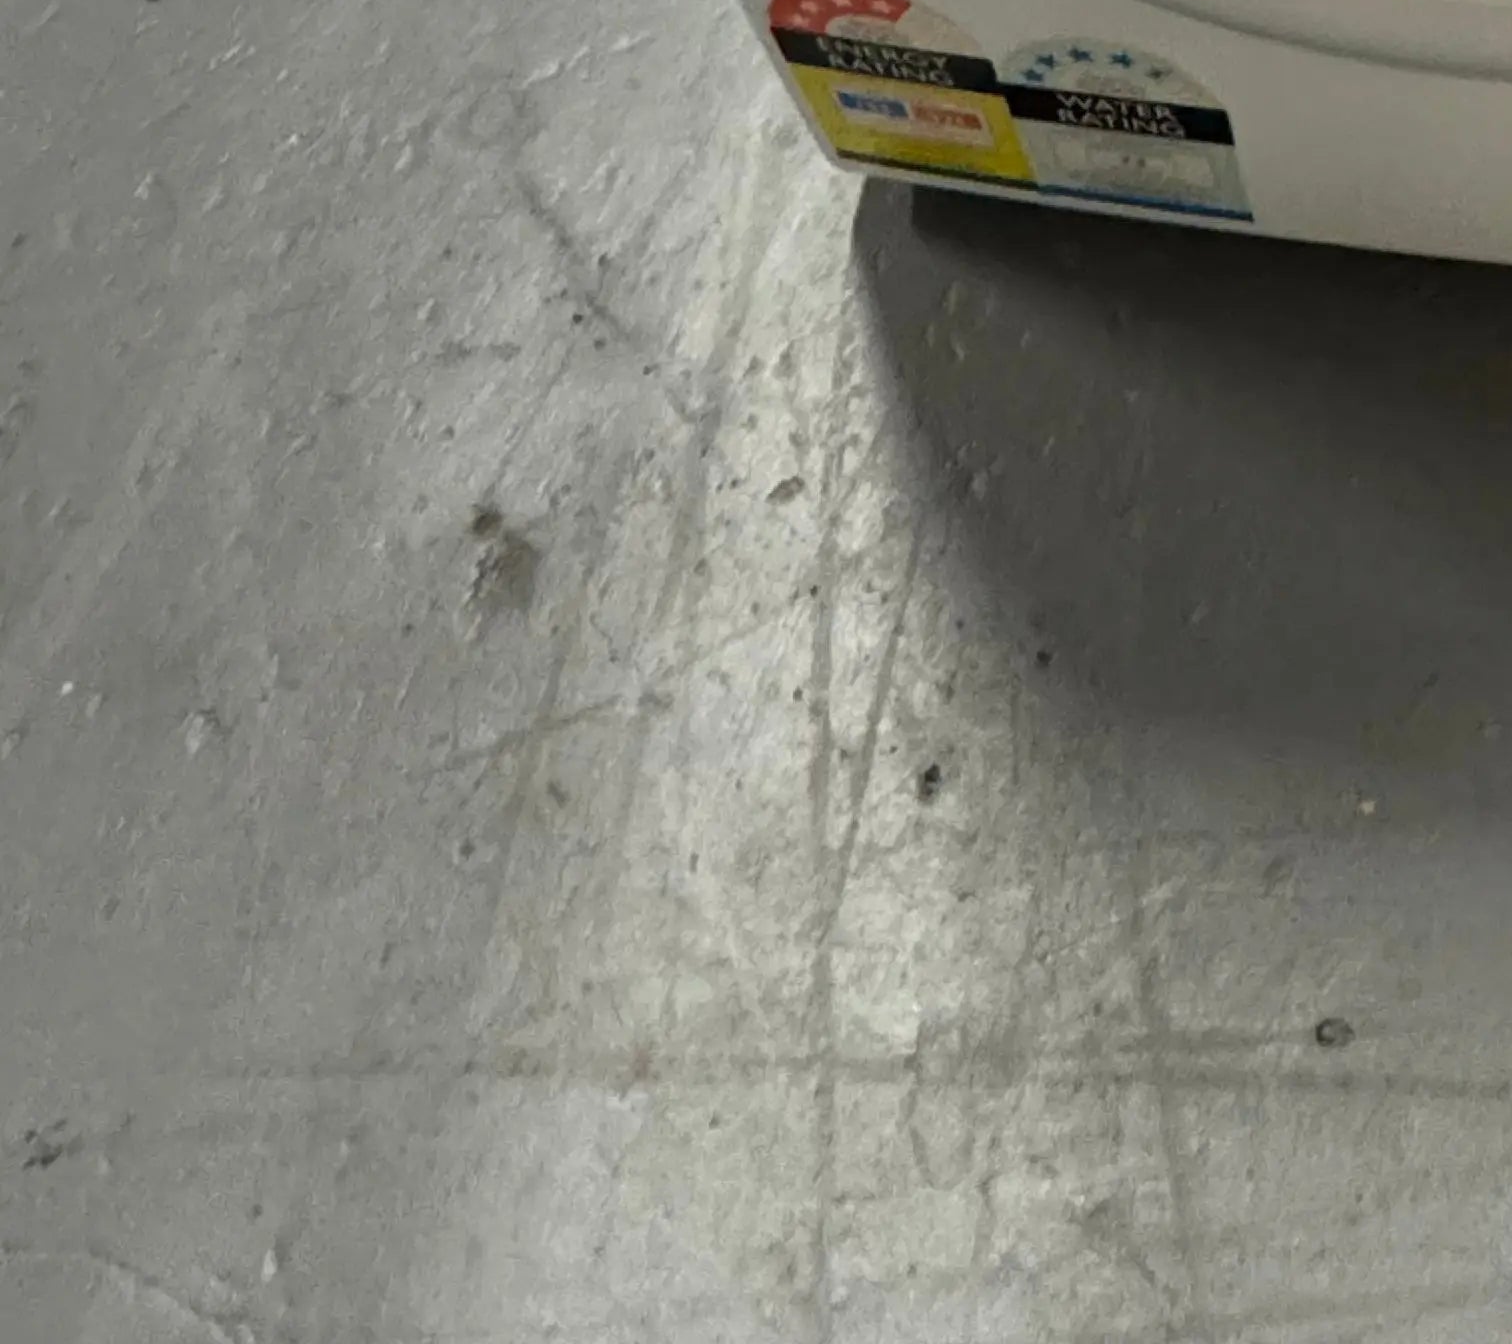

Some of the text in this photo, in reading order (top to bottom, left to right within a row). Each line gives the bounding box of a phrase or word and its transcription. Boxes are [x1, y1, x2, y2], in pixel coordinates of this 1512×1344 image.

[816, 36, 947, 68] ENERGY
[828, 54, 953, 88] RATING
[1055, 92, 1176, 118] WATER
[1056, 106, 1188, 140] RATING
